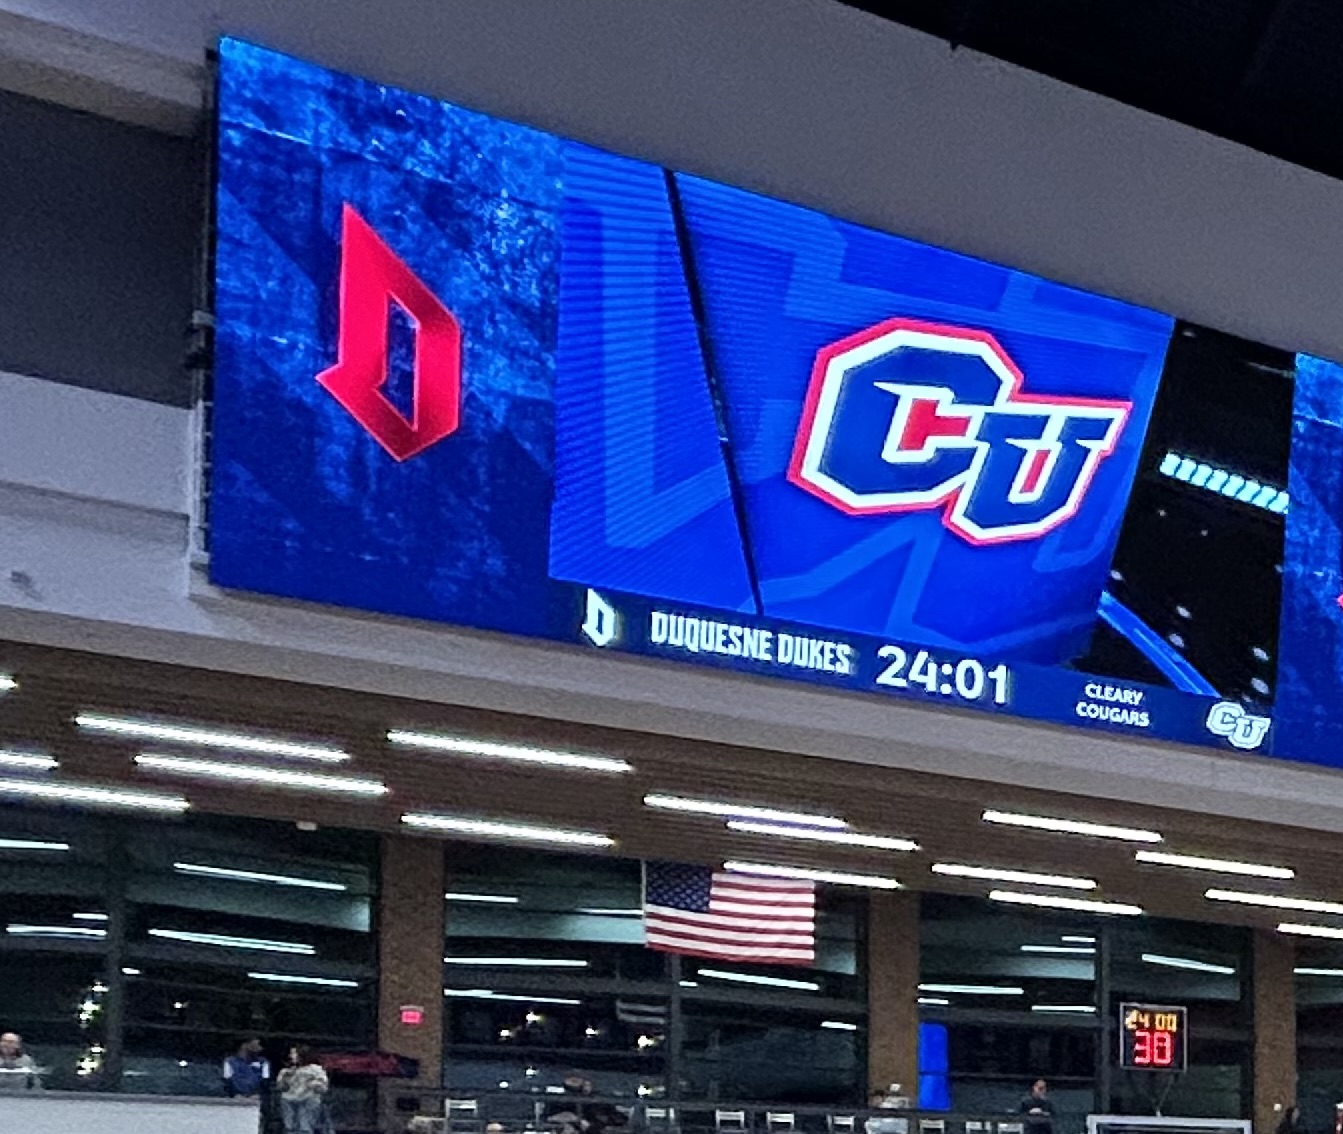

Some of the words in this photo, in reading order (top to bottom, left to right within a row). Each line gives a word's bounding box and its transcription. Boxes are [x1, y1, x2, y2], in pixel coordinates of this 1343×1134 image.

[789, 317, 1132, 546] CU
[650, 611, 773, 661] DUQUESNE
[777, 633, 853, 674] DUKES
[876, 645, 1008, 704] 24:01
[1084, 683, 1144, 706] CLEARY
[1075, 702, 1150, 727] COUGARS
[1205, 701, 1271, 749] CU
